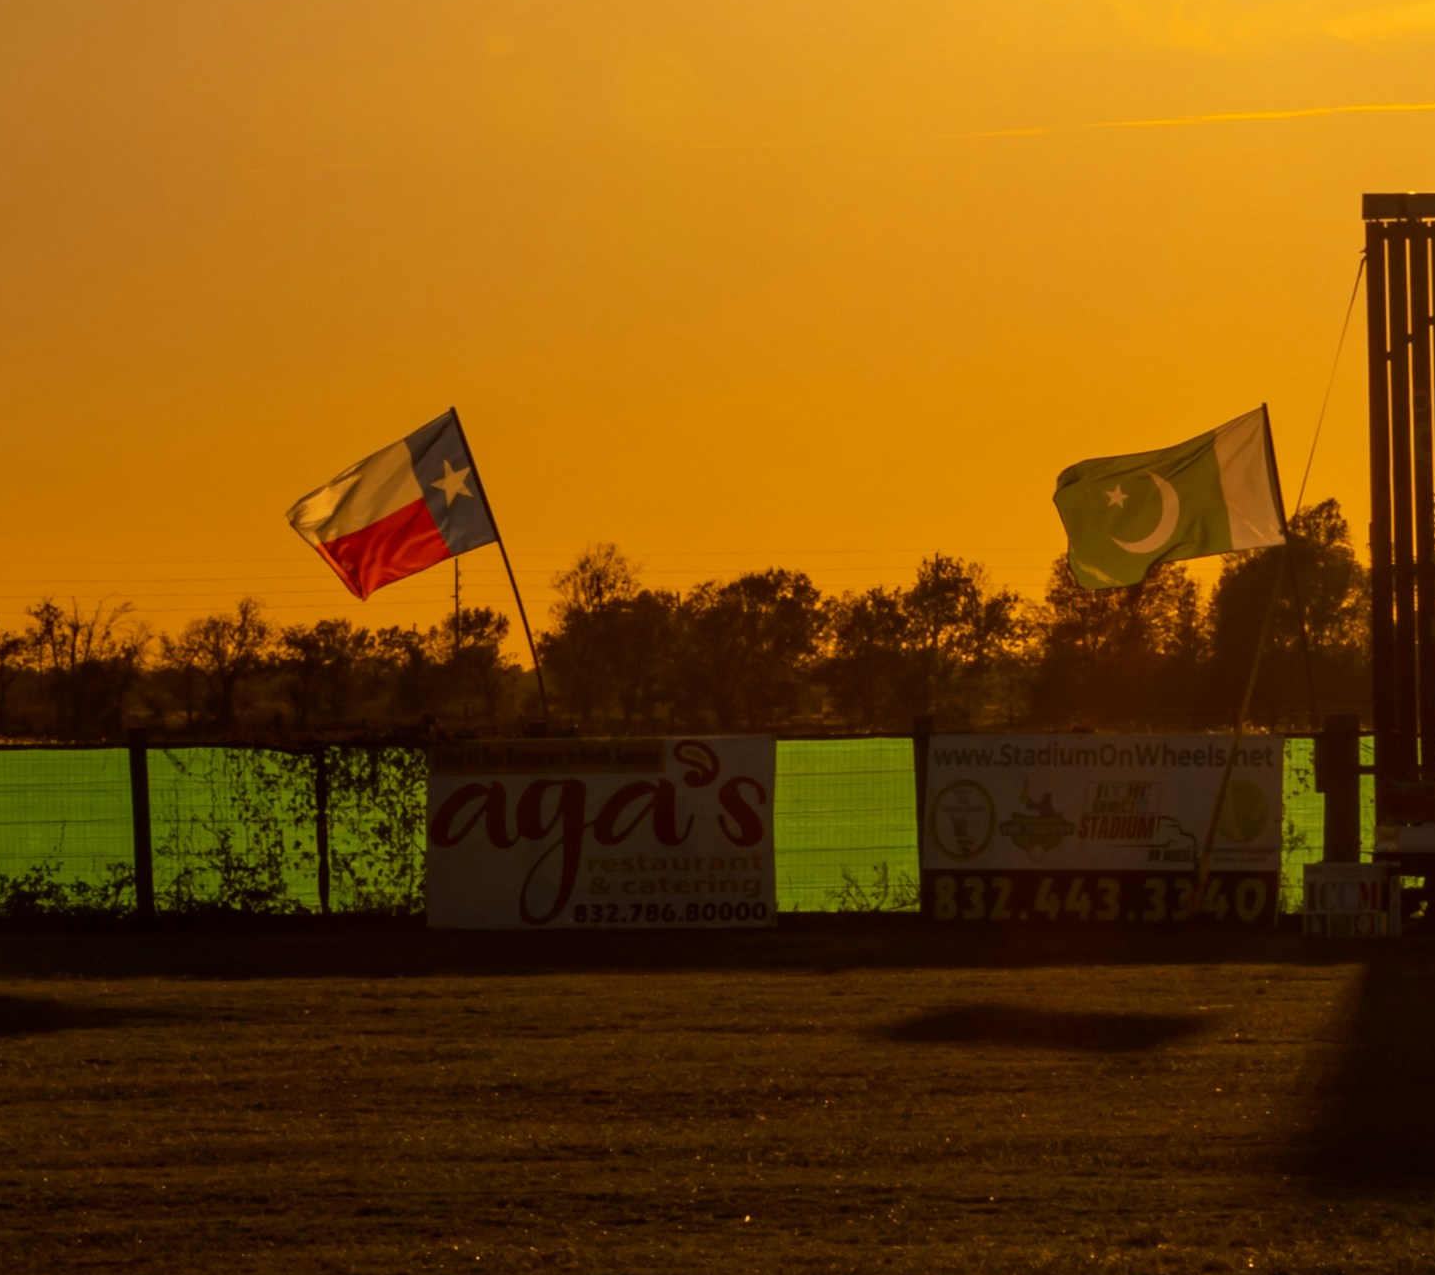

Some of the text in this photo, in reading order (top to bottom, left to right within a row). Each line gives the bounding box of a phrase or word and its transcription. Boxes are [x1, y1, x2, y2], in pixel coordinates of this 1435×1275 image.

[934, 740, 1275, 768] www.StadiumOnWheelsnet
[431, 739, 766, 925] aga's
[1078, 815, 1156, 839] STADIUM
[586, 853, 763, 874] restaurant
[588, 875, 763, 898] & catering
